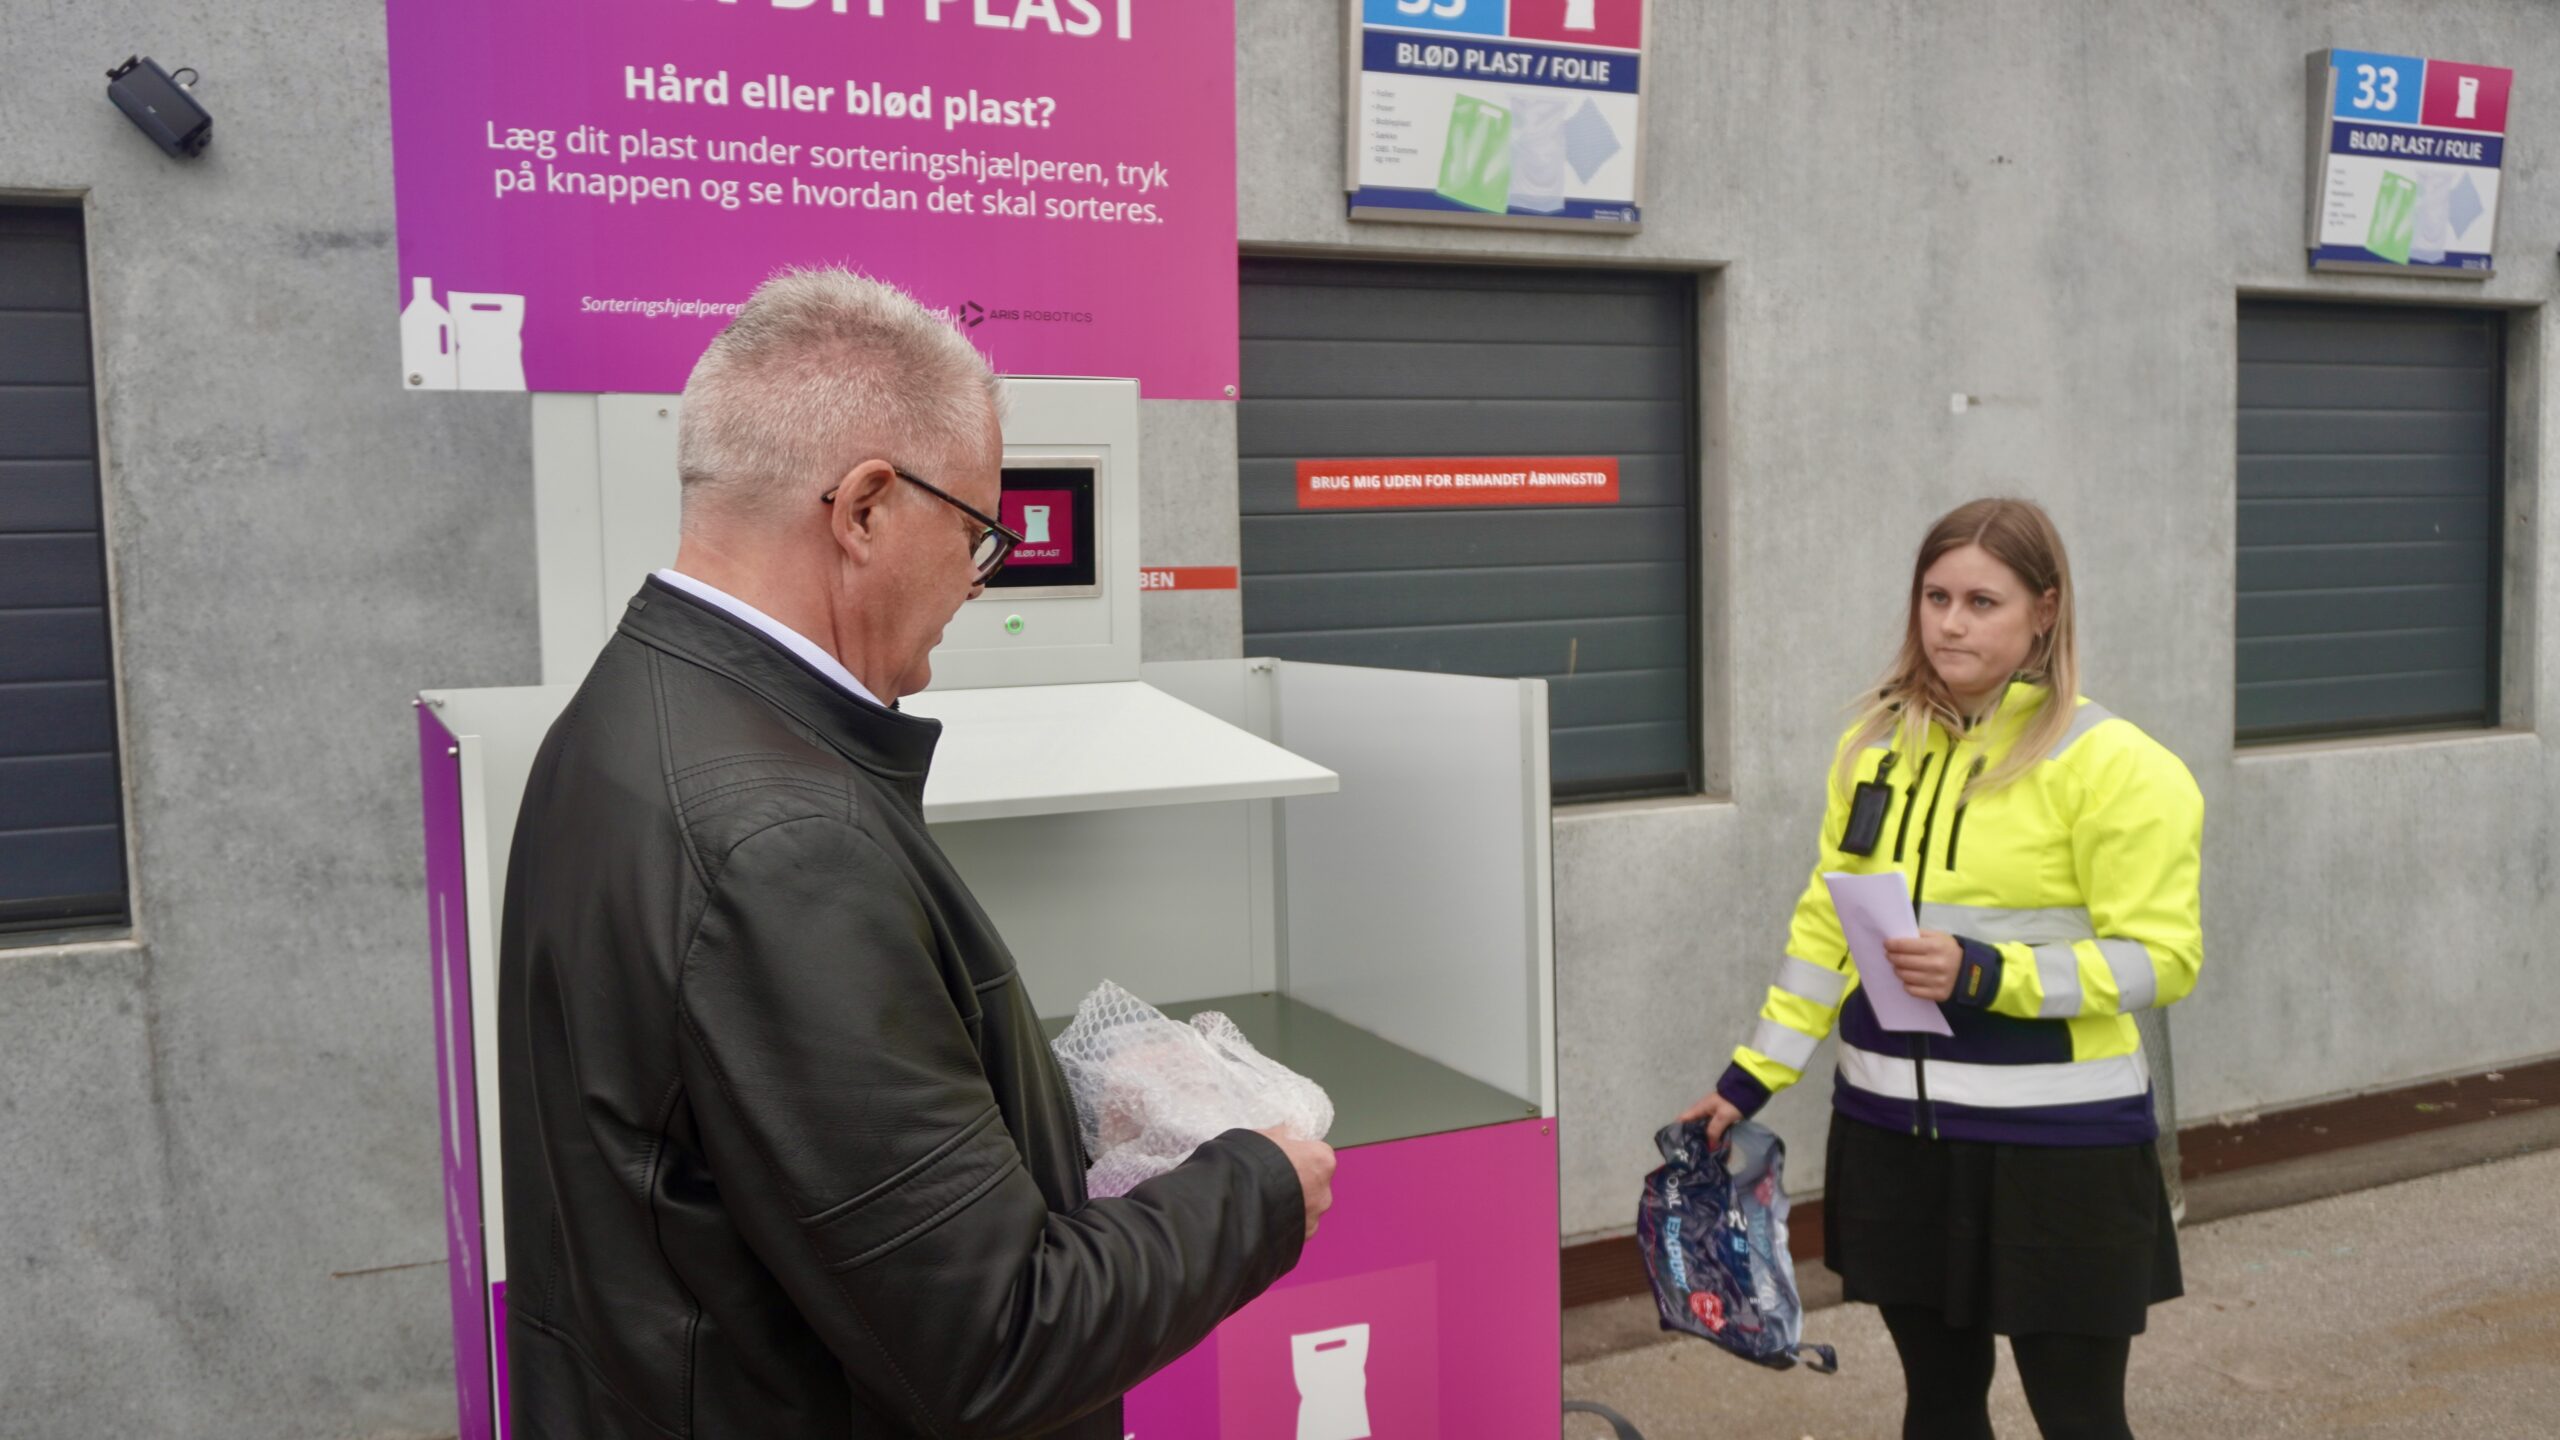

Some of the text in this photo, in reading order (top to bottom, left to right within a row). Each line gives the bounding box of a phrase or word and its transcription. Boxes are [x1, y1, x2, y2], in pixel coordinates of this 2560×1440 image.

[1397, 42, 1610, 82] BLØD PLAST / FOLIE
[625, 63, 1056, 131] Hård eller blød plast?
[2353, 64, 2398, 111] 33
[487, 120, 1169, 193] Læg dit plast under sorteringshjælperen, tryk
[2350, 130, 2389, 151] BLØD
[2391, 134, 2434, 156] PLAST
[2445, 140, 2483, 161] FOLIE
[494, 160, 1164, 224] på knappen og se hvordan det skal sorteres.
[989, 309, 1093, 323] ARIS ROBOTICS
[1310, 470, 1607, 489] BRUG MIG UDEN FOR BEMANDET ÅBNINGSTID
[1013, 548, 1060, 558] BLØD PLAST
